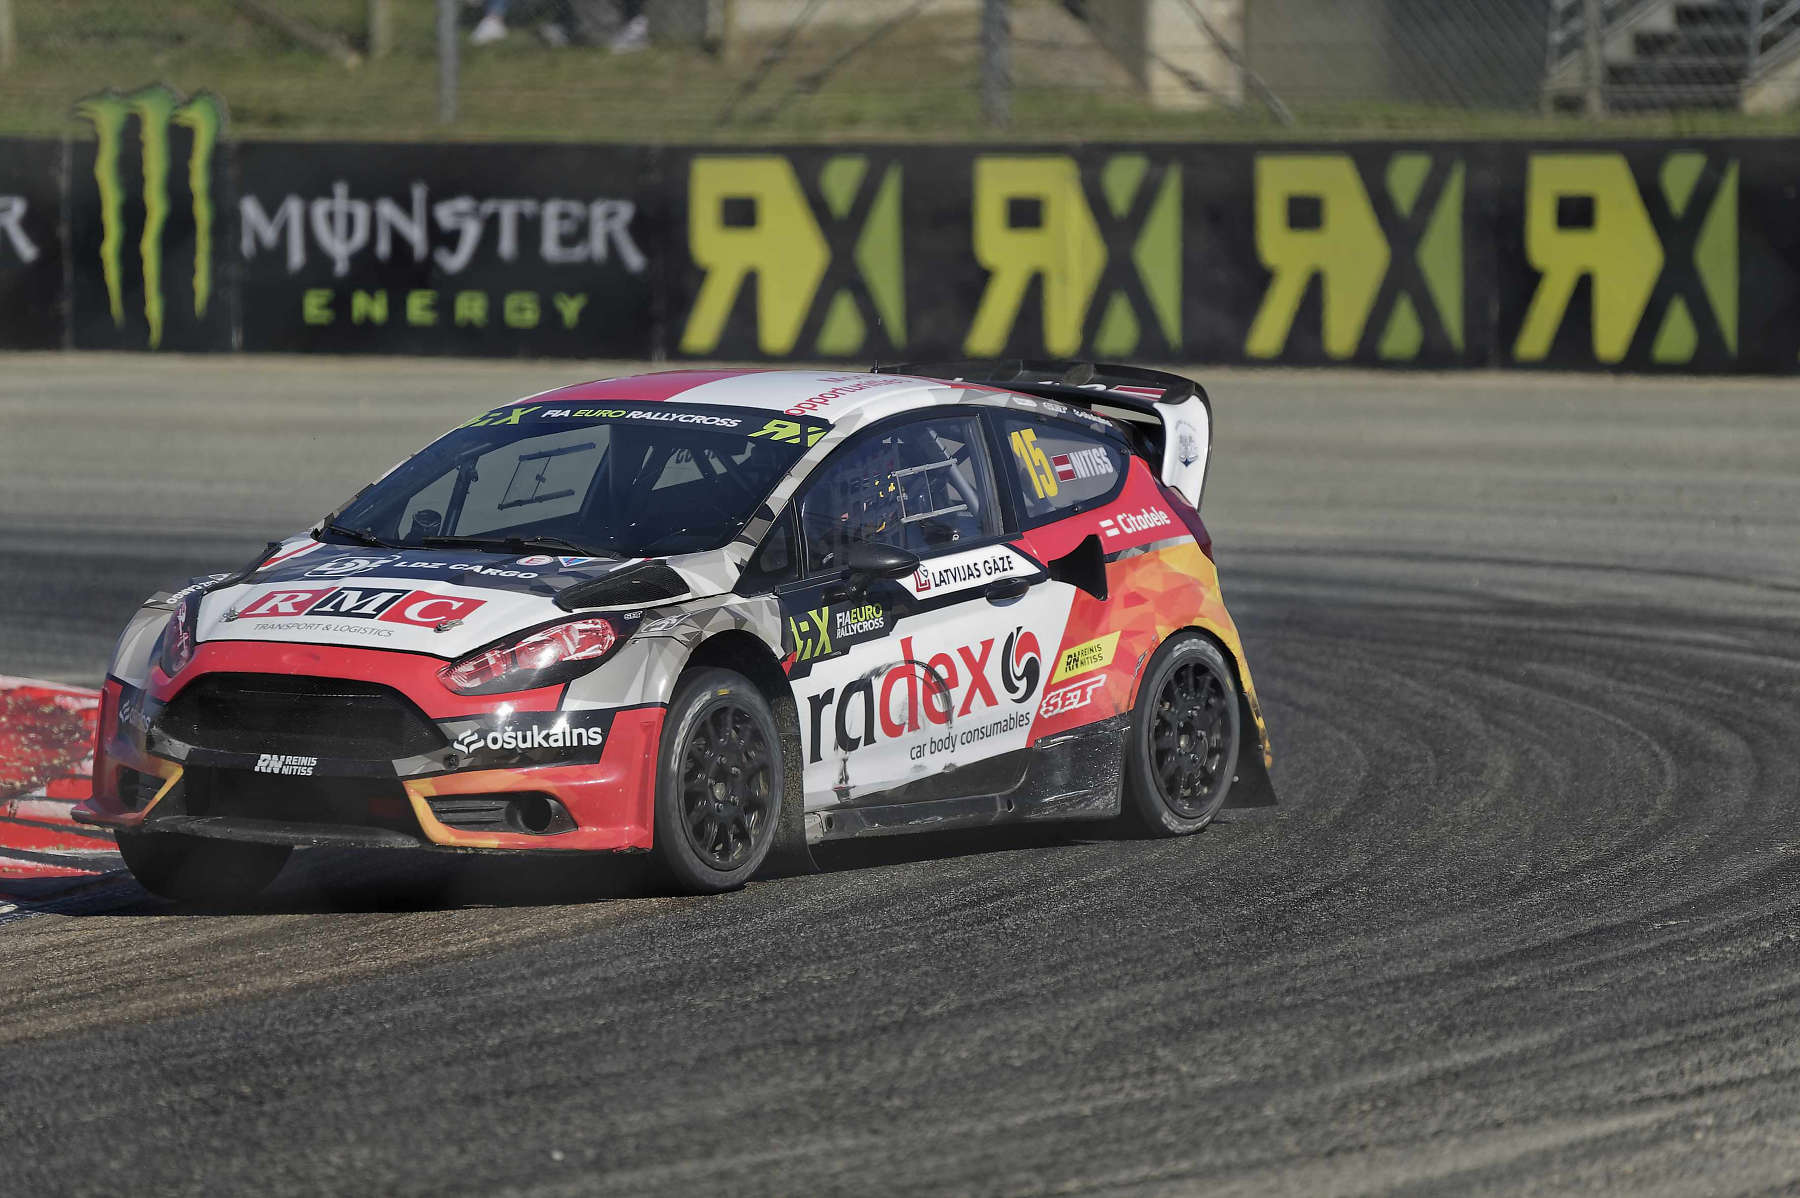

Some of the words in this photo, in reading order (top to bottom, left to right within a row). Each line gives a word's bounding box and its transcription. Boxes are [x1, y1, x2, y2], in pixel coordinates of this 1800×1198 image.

[240, 181, 646, 276] MONSTER
[681, 156, 905, 355] RX
[964, 154, 1183, 357] RX
[1245, 153, 1464, 358] RX
[1514, 153, 1739, 361] RX
[303, 289, 588, 329] ENERGY
[541, 409, 571, 418] FIA
[572, 409, 626, 418] EURO
[625, 410, 743, 428] RALLYCROSS
[1011, 428, 1059, 499] 15
[1070, 446, 1114, 480] NITISS
[1116, 505, 1171, 534] Citadele
[449, 563, 539, 579] CARGO
[931, 562, 981, 588] LATVIJAS
[246, 589, 464, 622] RMC
[254, 622, 319, 632] TRANSPORT
[332, 623, 395, 638] LOGISTICS
[836, 617, 884, 639] RALLYCROSS
[807, 635, 999, 764] radex
[486, 724, 603, 750] ošukalns
[910, 743, 926, 760] car
[929, 732, 958, 753] body
[960, 711, 1030, 745] consumables
[281, 766, 314, 777] NITISS
[285, 755, 318, 766] REINIS
